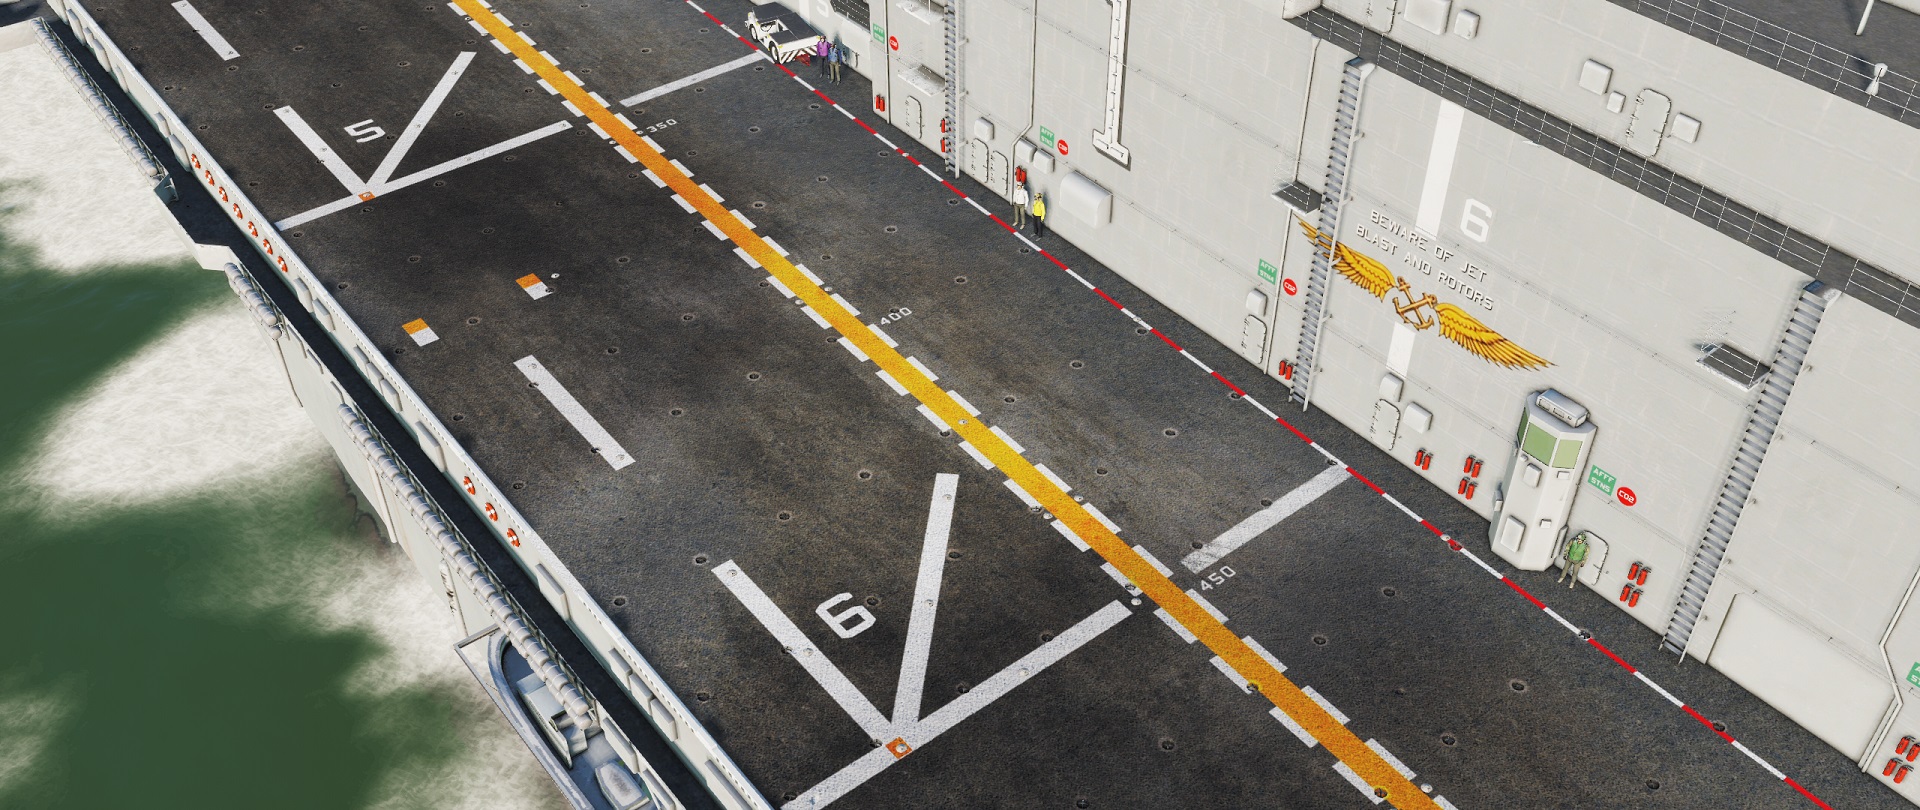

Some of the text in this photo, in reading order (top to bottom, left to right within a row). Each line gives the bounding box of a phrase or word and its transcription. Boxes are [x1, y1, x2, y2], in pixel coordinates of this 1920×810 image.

[343, 118, 386, 143] 5
[646, 118, 677, 133] 350
[1460, 198, 1493, 243] 6
[1370, 208, 1487, 283] BEWARE OF JET
[1356, 223, 1495, 312] BLAST AND ROTORS
[880, 307, 913, 325] 400
[1593, 467, 1615, 483] AFFF
[1618, 489, 1635, 504] CO2
[1200, 565, 1237, 591] 450
[815, 592, 876, 639] 6
